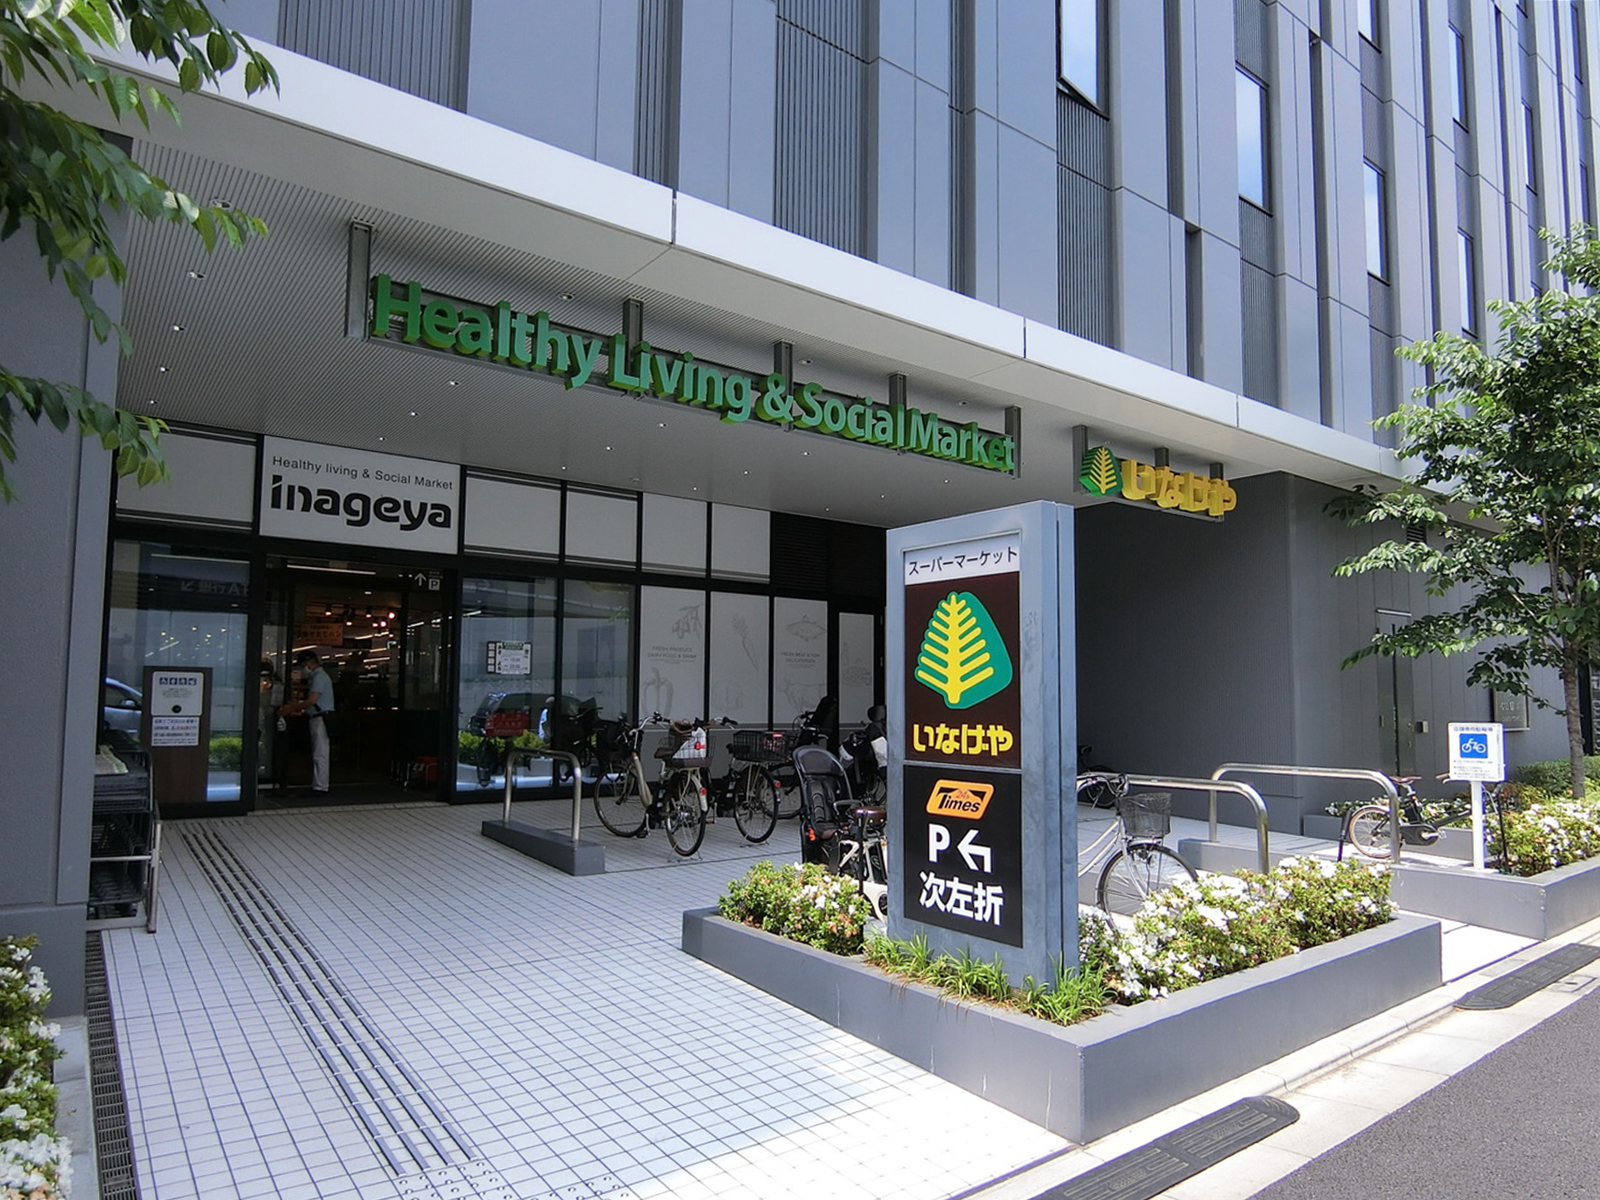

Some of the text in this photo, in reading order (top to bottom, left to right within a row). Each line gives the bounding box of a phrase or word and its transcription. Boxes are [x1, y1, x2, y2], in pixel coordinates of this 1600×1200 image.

[371, 272, 1016, 472] Healthy Living & Social Market
[272, 456, 453, 490] Healthy living & Social Market
[271, 474, 451, 531] inageya
[908, 547, 1018, 576] スーパーマーケット
[913, 724, 1014, 756] いなげや
[938, 794, 981, 812] Times
[928, 823, 951, 863] P
[919, 870, 1004, 926] 次左折
